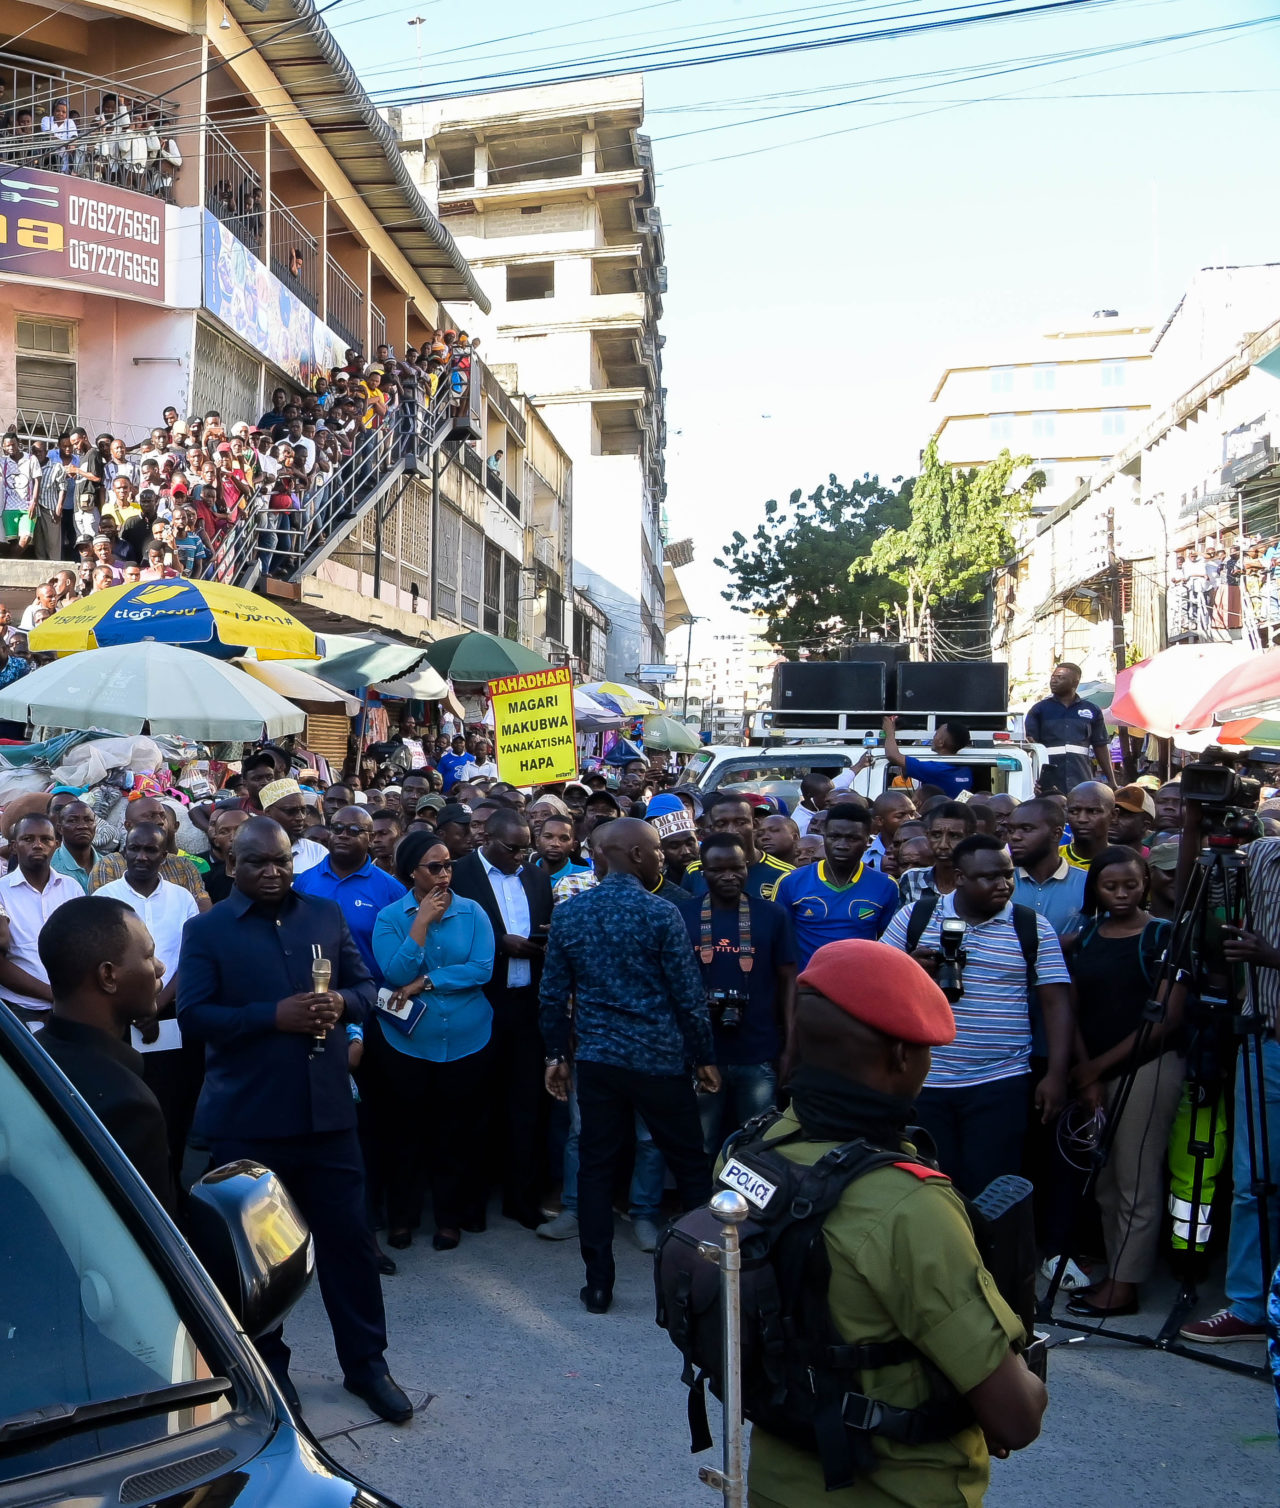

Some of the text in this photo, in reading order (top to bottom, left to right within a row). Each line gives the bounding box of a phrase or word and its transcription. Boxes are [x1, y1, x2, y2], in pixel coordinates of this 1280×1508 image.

[69, 195, 160, 246] 0769275650
[69, 239, 159, 287] 0672275659
[489, 668, 570, 694] TAHADHARI
[508, 695, 558, 714] MAGARI
[501, 715, 569, 736] MAKUBWA
[500, 735, 572, 754] YANAKATISHA
[520, 756, 555, 772] HAPA
[725, 1165, 770, 1201] POLICE
